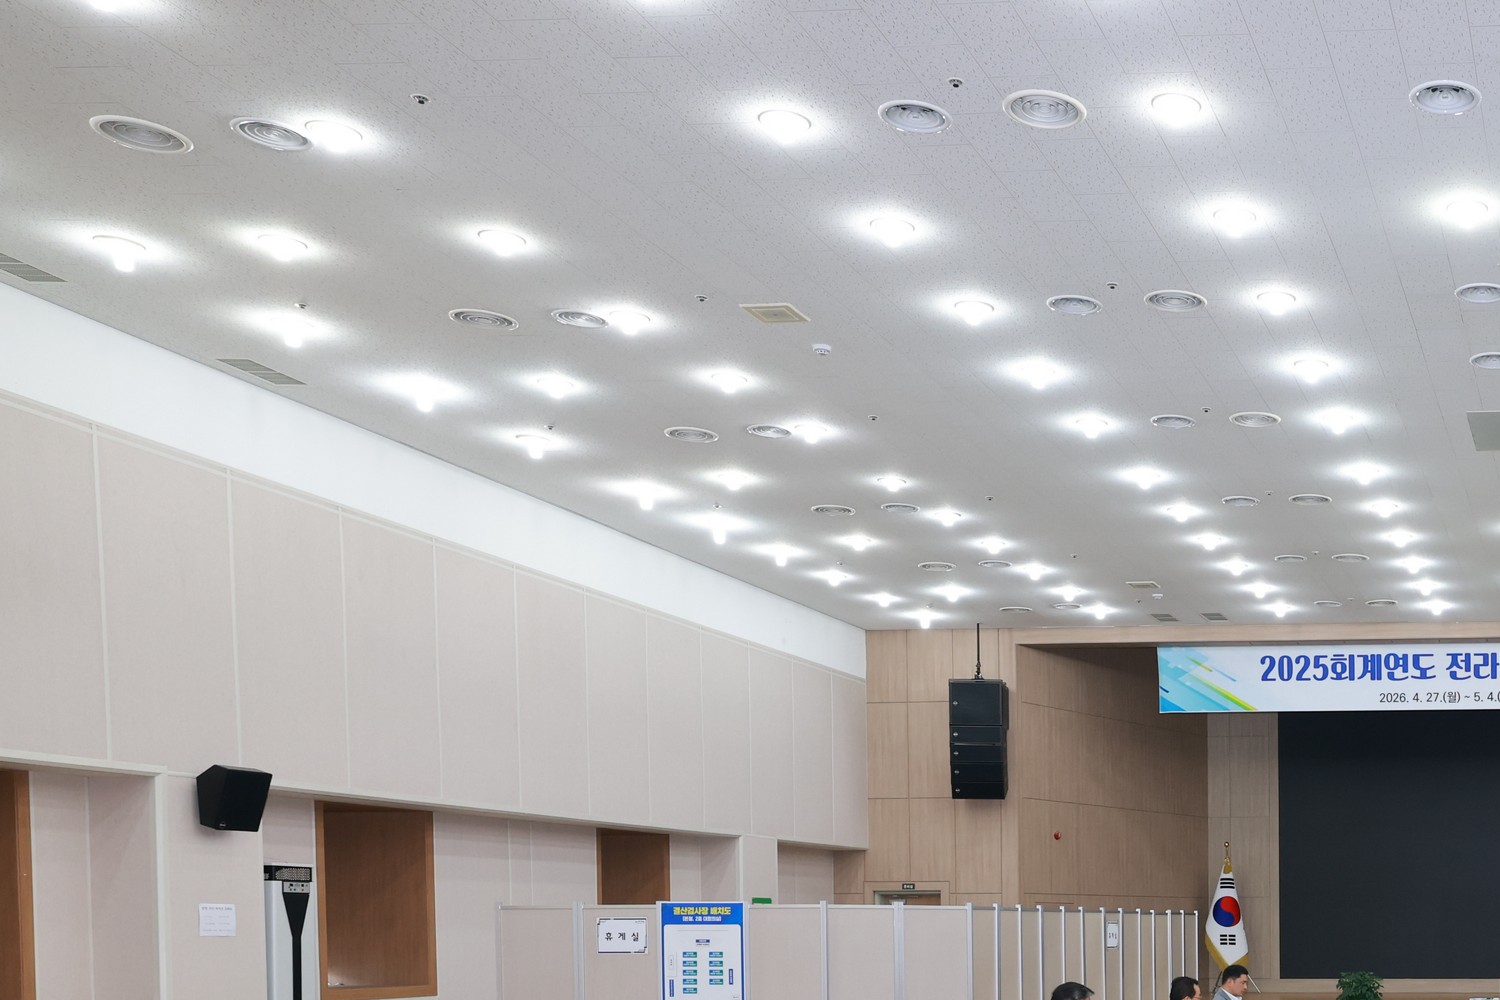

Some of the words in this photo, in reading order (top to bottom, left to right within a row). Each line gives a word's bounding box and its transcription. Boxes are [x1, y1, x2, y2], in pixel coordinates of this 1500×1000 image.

[1260, 652, 1437, 682] 2025회계연도
[1379, 692, 1409, 703] 2026.
[1412, 692, 1423, 703] 4.
[1426, 691, 1461, 704] 27.(월)
[1473, 691, 1484, 702] 5.
